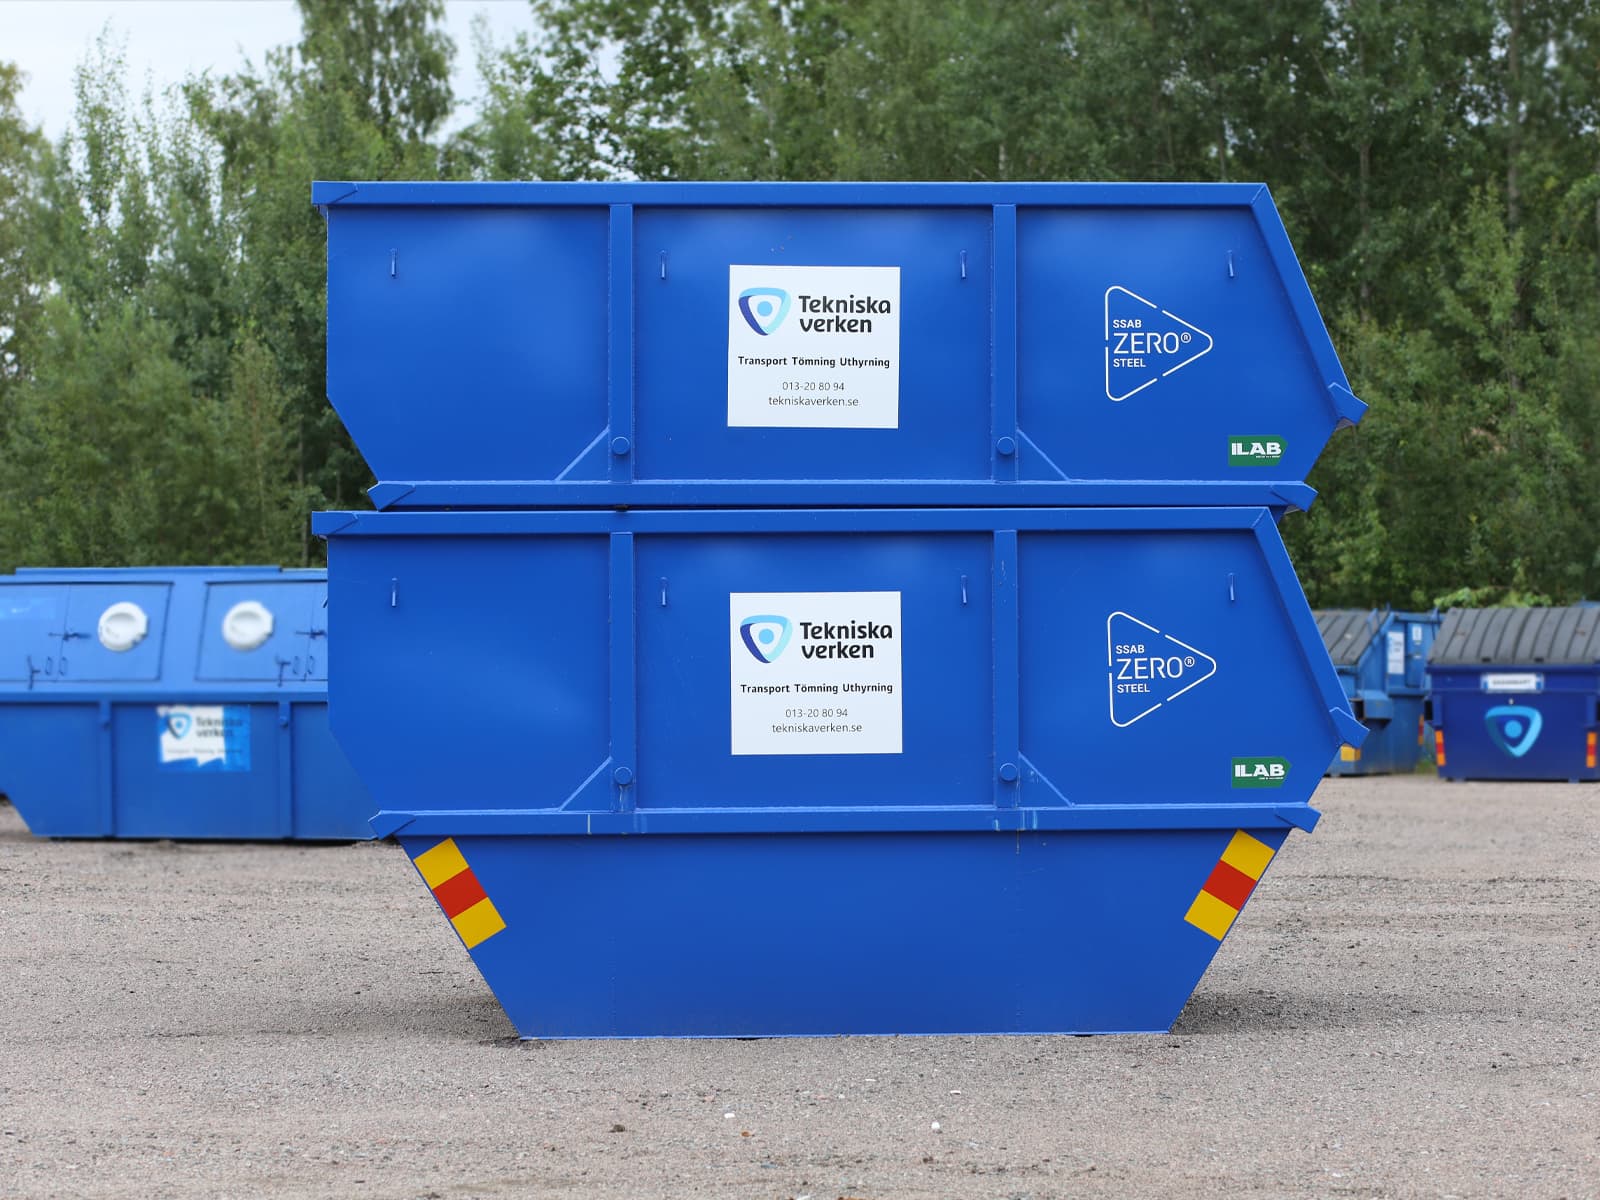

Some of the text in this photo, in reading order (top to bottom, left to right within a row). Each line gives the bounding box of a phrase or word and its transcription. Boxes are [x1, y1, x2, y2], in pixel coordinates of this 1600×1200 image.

[798, 294, 891, 314] Tekniska
[799, 315, 873, 333] verken
[1112, 319, 1142, 329] SSAB
[737, 356, 890, 369] Transport Tömning Uthyrning
[1112, 358, 1147, 368] STEEL
[782, 381, 845, 391] 013-20 80 94
[768, 395, 859, 407] tekniskaverken.se
[1231, 442, 1282, 456] ILAB
[799, 619, 893, 640] Tekniska
[801, 641, 874, 659] verken
[1115, 644, 1145, 655] SSAB
[740, 682, 893, 695] Transport Tömning Uthyrning
[1116, 683, 1151, 693] STEEL
[785, 708, 848, 718] 013-20 80 94
[771, 722, 863, 733] tekniskaverken.se
[1234, 763, 1285, 777] ILAB
